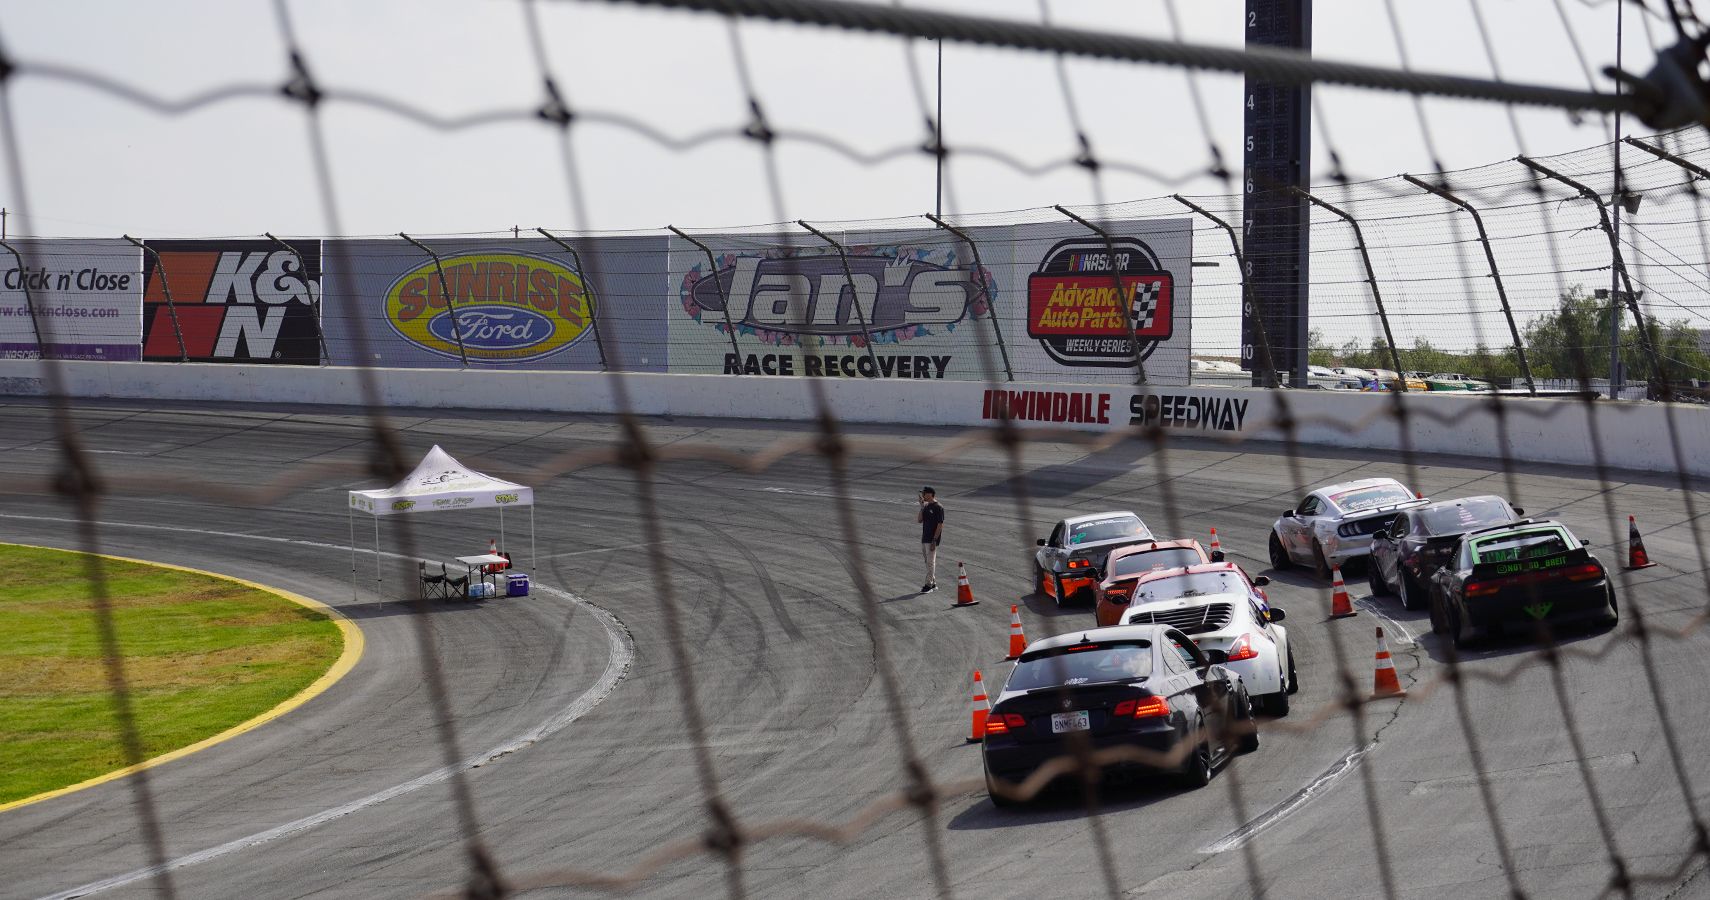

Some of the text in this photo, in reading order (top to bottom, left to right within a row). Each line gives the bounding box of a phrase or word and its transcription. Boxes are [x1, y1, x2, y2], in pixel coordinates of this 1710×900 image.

[1248, 11, 1256, 27] 2
[1247, 94, 1255, 110] 4
[1246, 135, 1254, 152] 5
[1246, 177, 1254, 194] 6
[1245, 219, 1254, 235] 7
[1083, 253, 1130, 271] NASCAR
[1245, 261, 1253, 277] 8
[4, 266, 51, 290] Click
[76, 267, 131, 291] Close
[397, 261, 583, 328] SUNRISE
[0, 304, 120, 318] w.clknclose.com
[1038, 307, 1124, 328] Auto Parts
[1244, 301, 1252, 318] 9
[450, 311, 533, 340] Ford
[1065, 338, 1132, 353] WEEKLY SERIES
[1241, 343, 1254, 360] 10
[723, 352, 952, 379] RACE RECOVERY
[982, 389, 1249, 431] IRWINDALE SPEEDWAY
